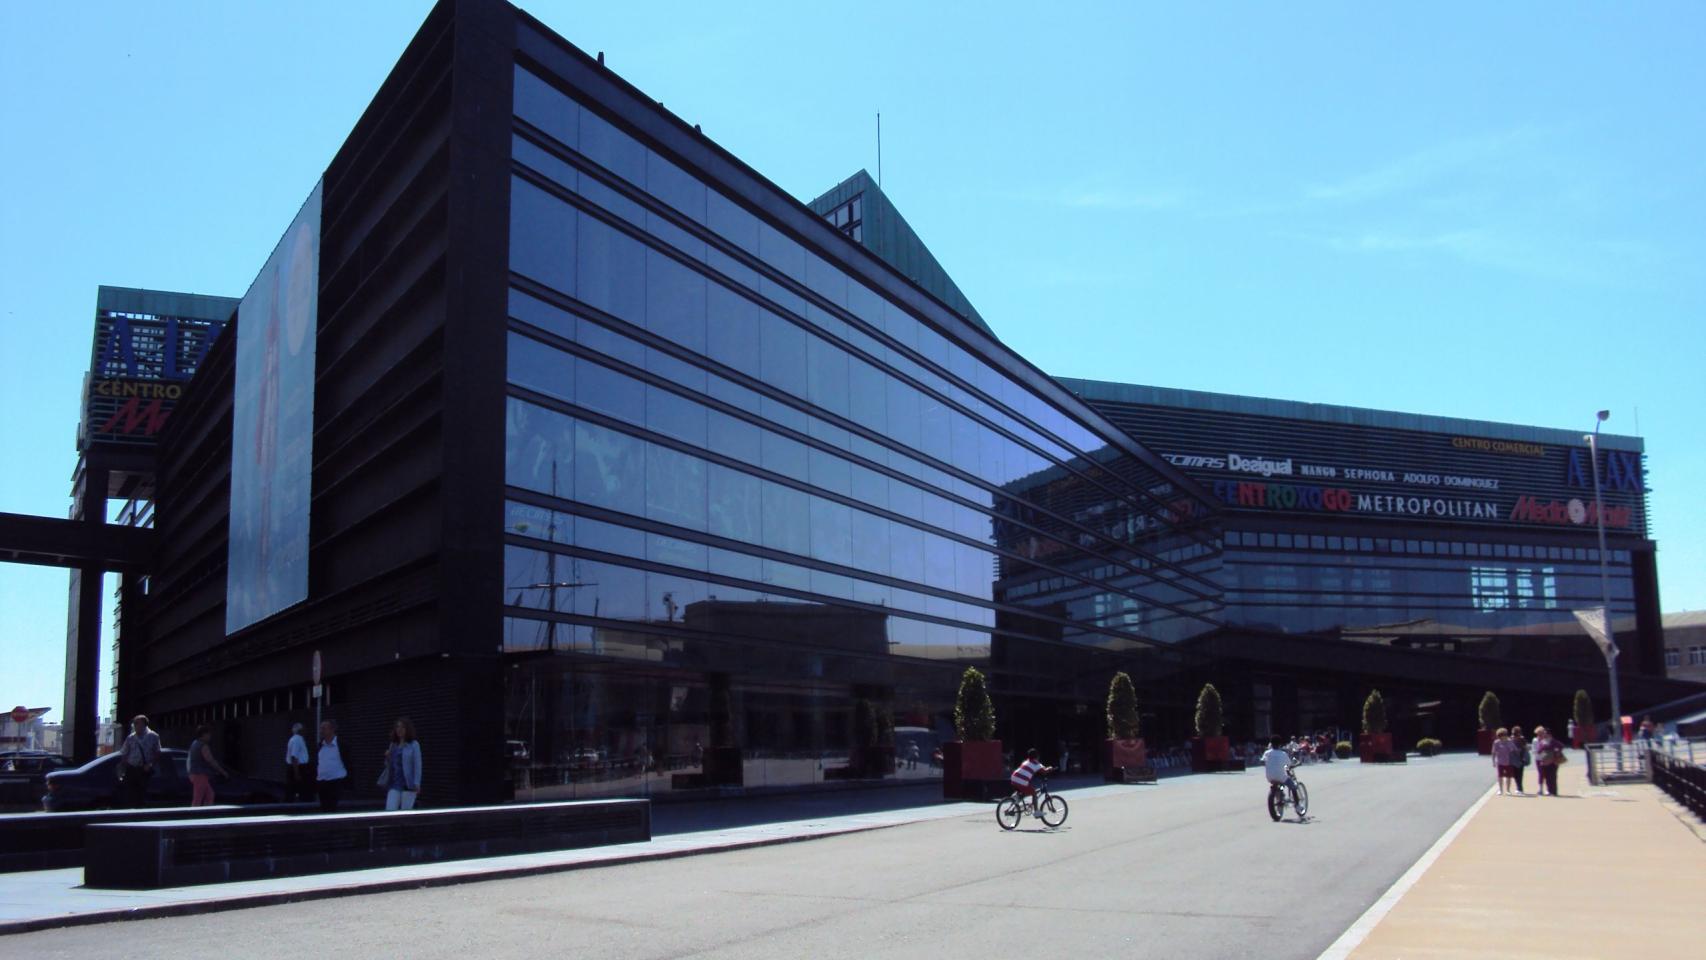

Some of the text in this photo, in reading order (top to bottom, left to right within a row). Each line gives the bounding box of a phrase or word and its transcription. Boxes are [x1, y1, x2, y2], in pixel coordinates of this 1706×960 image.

[97, 381, 182, 399] CENTRO
[1452, 437, 1545, 457] CENTRO COMERCIAL
[1228, 454, 1293, 476] Desigual
[1301, 464, 1336, 477] MANGO
[1567, 448, 1585, 488] A
[1344, 468, 1395, 482] SEPHORA
[1403, 473, 1499, 490] ADOLFO DOMINGUEZ
[1357, 495, 1498, 518] METROPOLITAN
